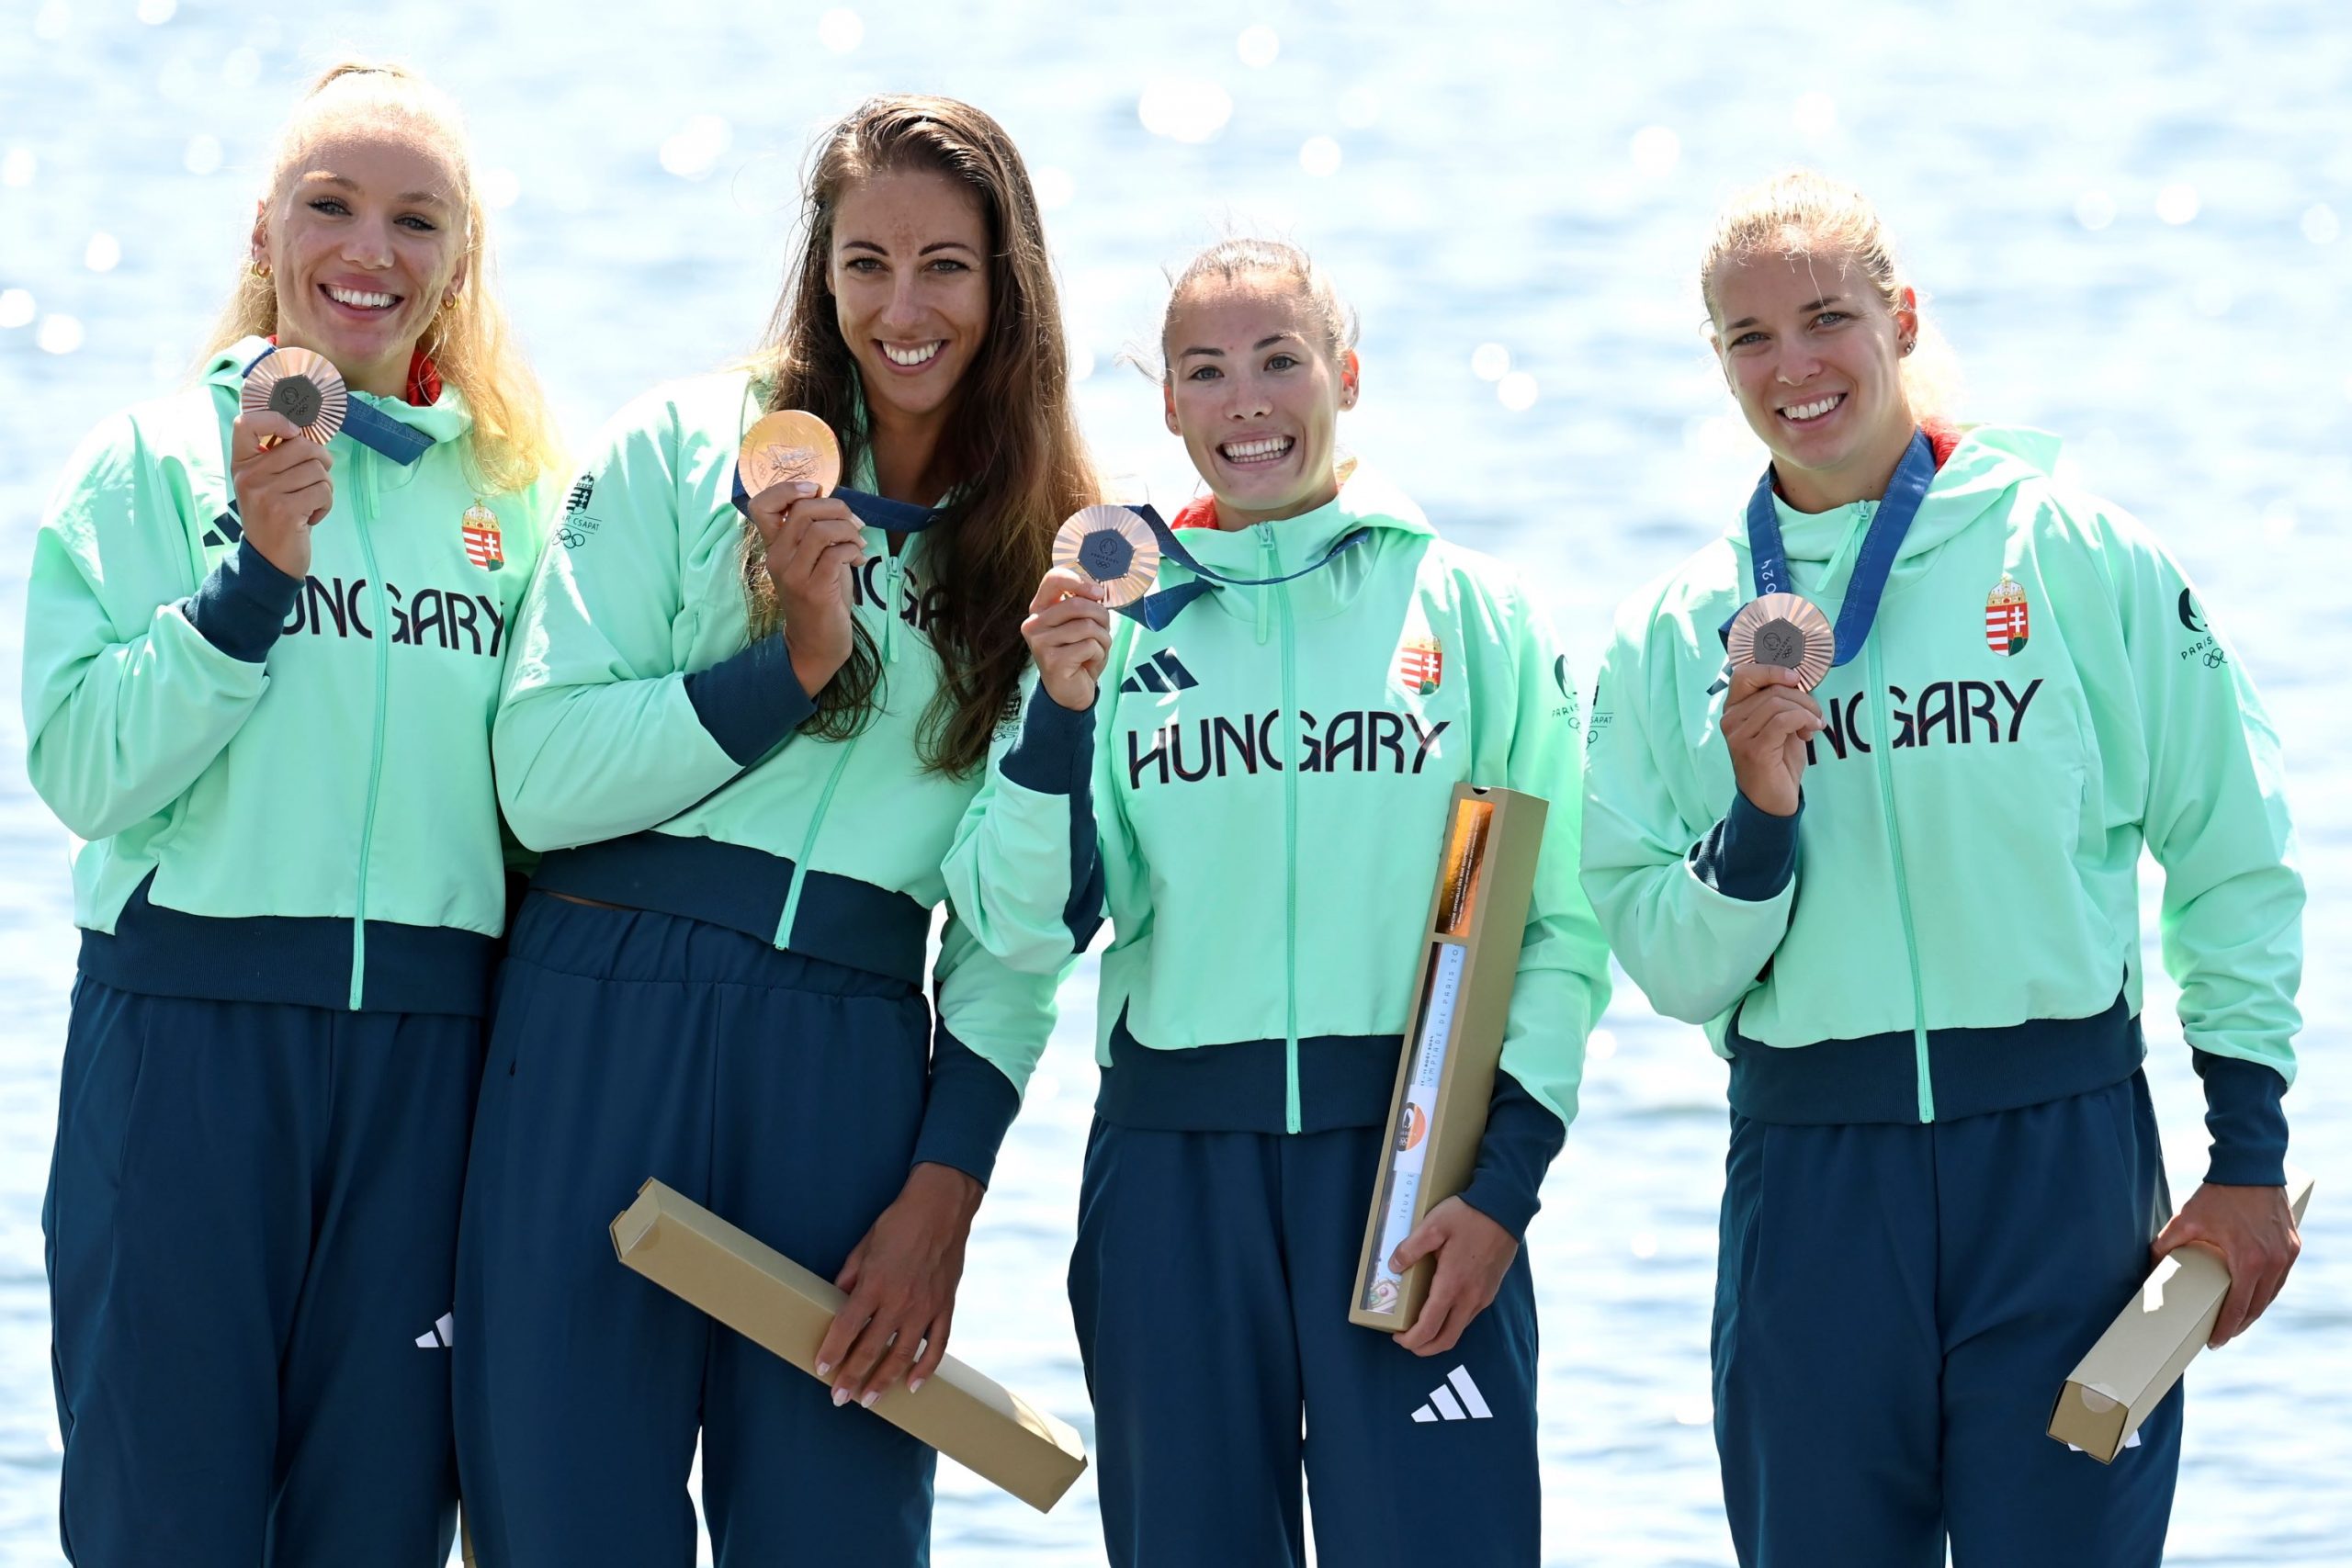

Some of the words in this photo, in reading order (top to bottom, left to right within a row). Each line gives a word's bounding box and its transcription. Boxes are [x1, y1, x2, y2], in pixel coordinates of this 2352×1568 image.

[572, 517, 600, 531] CSAPAT
[1761, 558, 1777, 594] 024
[281, 575, 504, 658] UNGARY
[2181, 636, 2213, 660] PARIS
[1590, 716, 1613, 725] SAPAT
[1805, 678, 2044, 766] NGARY
[1127, 708, 1452, 790] HUNGARY
